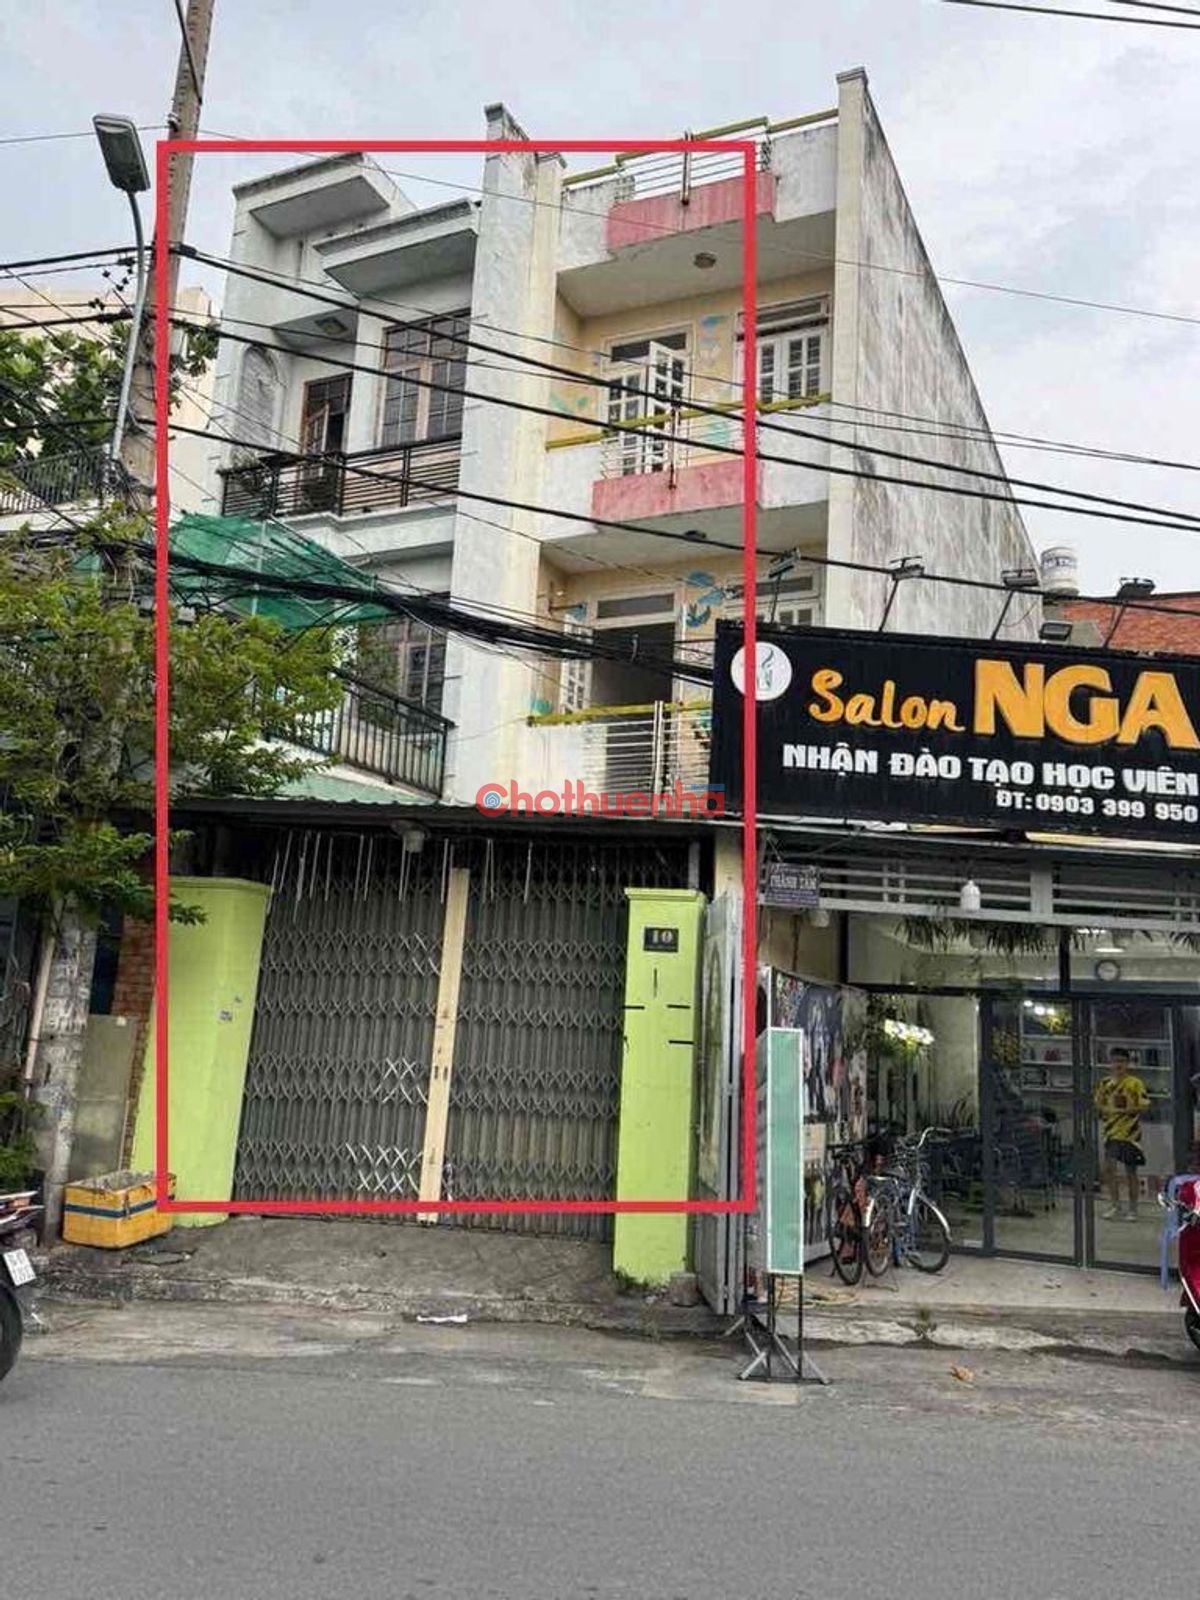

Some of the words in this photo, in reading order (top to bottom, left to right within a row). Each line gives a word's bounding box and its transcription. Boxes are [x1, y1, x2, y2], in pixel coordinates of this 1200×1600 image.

[808, 669, 965, 732] Salon
[973, 658, 1200, 750] NGA
[783, 742, 878, 776] NHẬN
[888, 748, 962, 779] ĐÀO
[968, 757, 1034, 787] TẠO
[1042, 762, 1115, 793] HỌC
[1122, 766, 1199, 796] VIÊN
[996, 789, 1032, 809] ĐT:
[1035, 793, 1095, 814] 0903
[1102, 799, 1146, 818] 399
[1155, 802, 1198, 822] 950
[651, 929, 673, 944] 10
